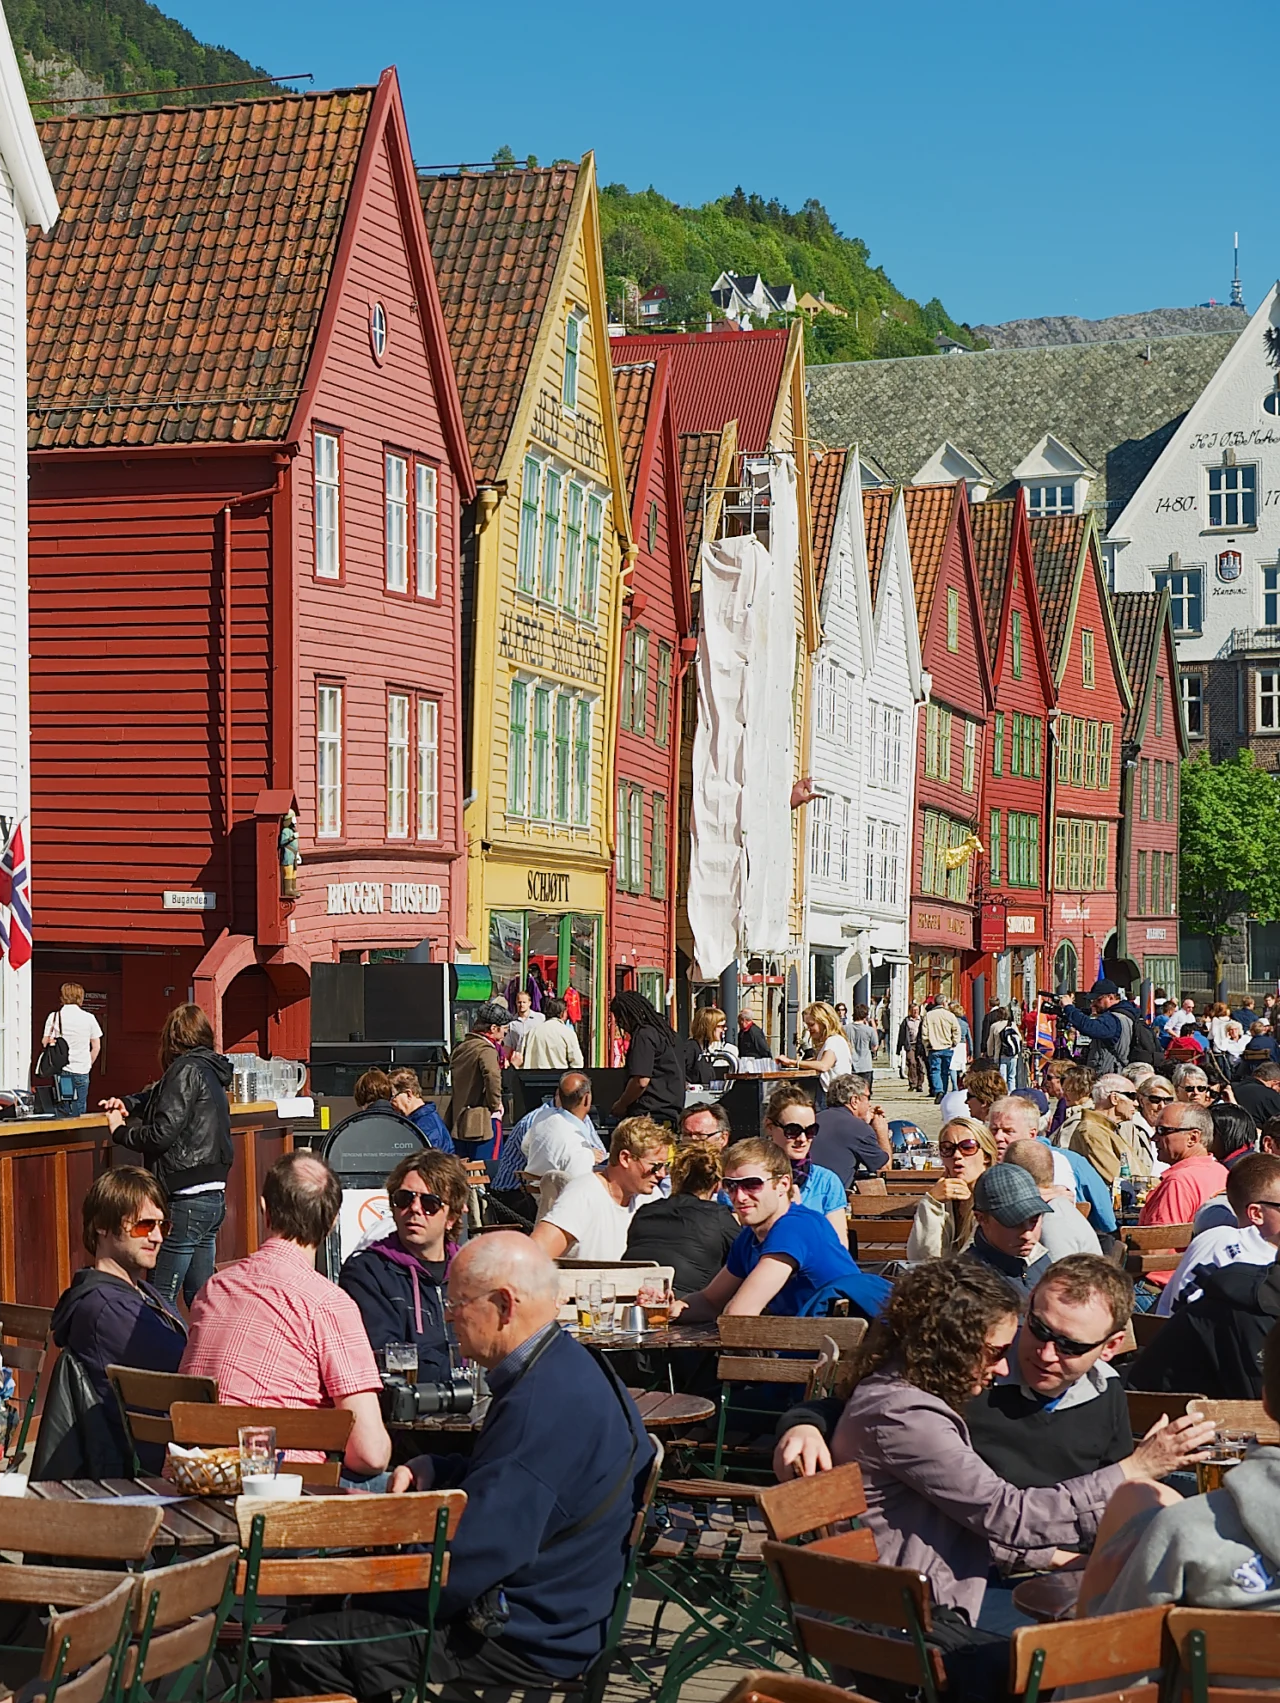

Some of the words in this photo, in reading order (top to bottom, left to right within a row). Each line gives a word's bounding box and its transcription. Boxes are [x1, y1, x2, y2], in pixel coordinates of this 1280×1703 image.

[1264, 489, 1280, 506] 17
[327, 881, 384, 914] BRYGGEN
[390, 882, 442, 914] HUSFLID
[527, 869, 570, 902] SCHJØTT
[391, 1141, 414, 1149] .com
